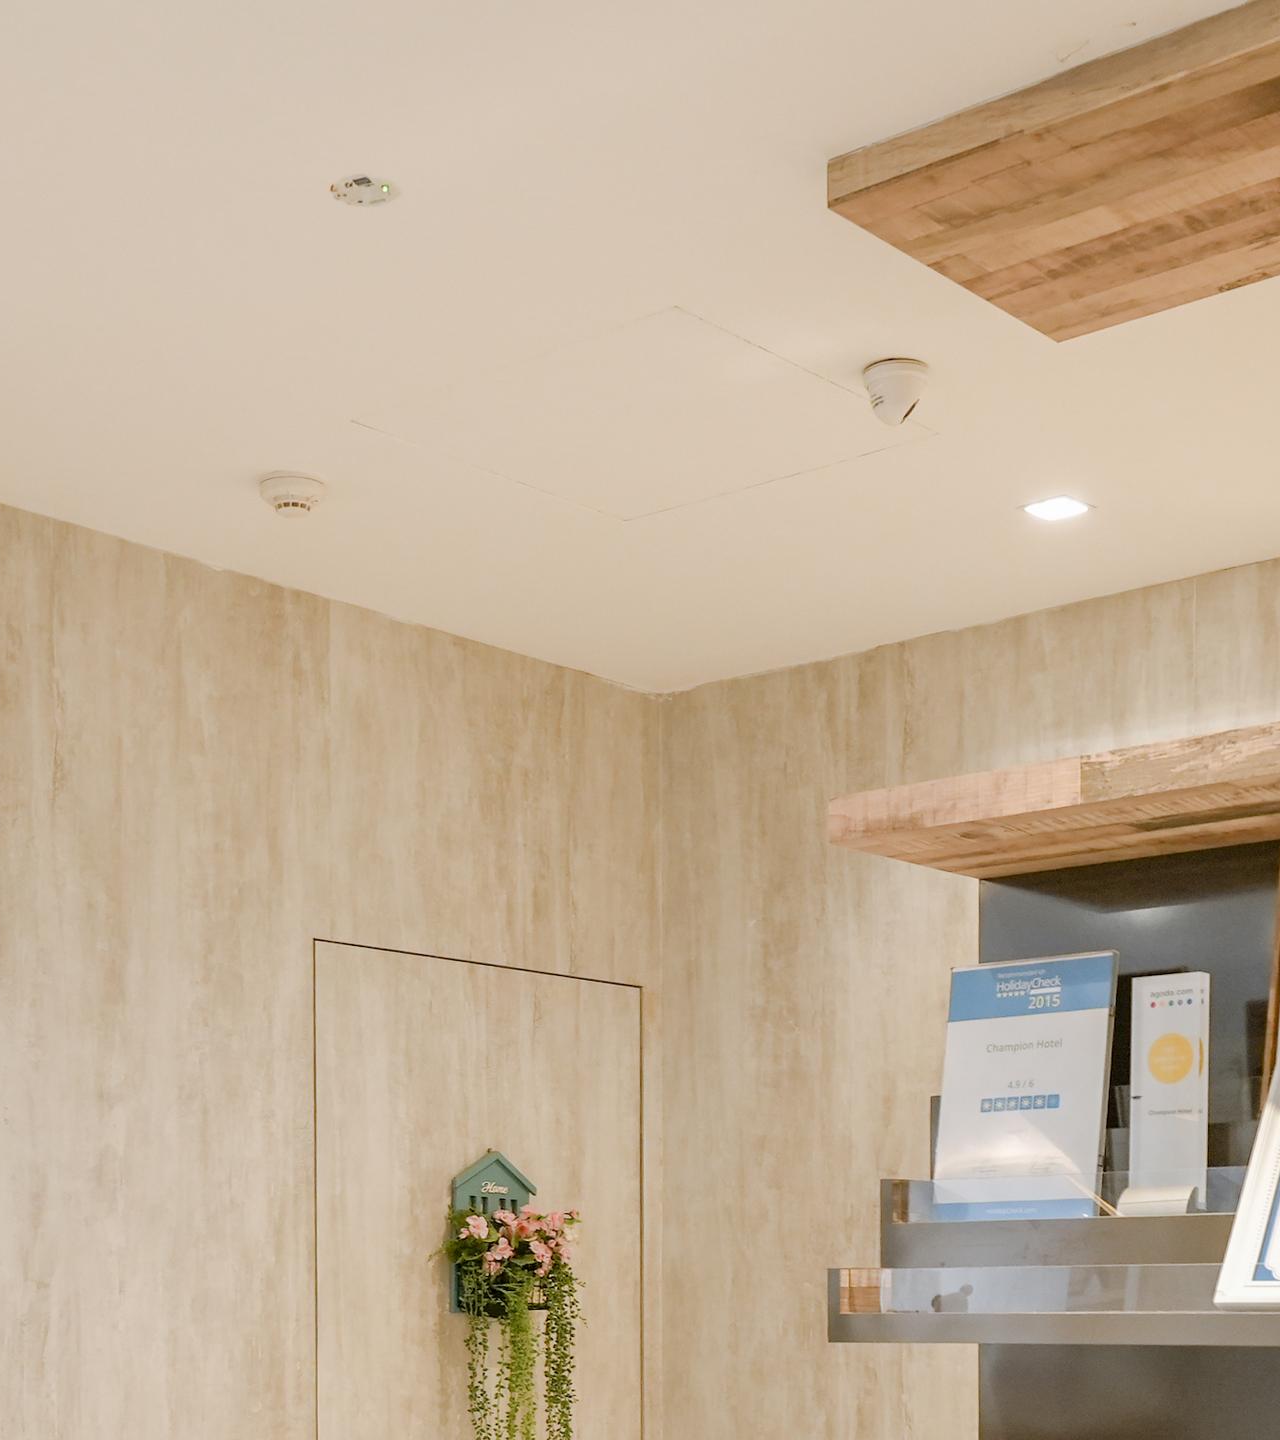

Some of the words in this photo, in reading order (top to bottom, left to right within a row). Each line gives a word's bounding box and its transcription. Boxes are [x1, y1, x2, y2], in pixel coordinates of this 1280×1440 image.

[996, 975, 1063, 995] HolidayCheck
[1028, 994, 1062, 1010] 2015
[985, 1041, 1034, 1055] Champion
[1036, 1038, 1063, 1050] Hotel
[481, 1181, 509, 1195] Home
